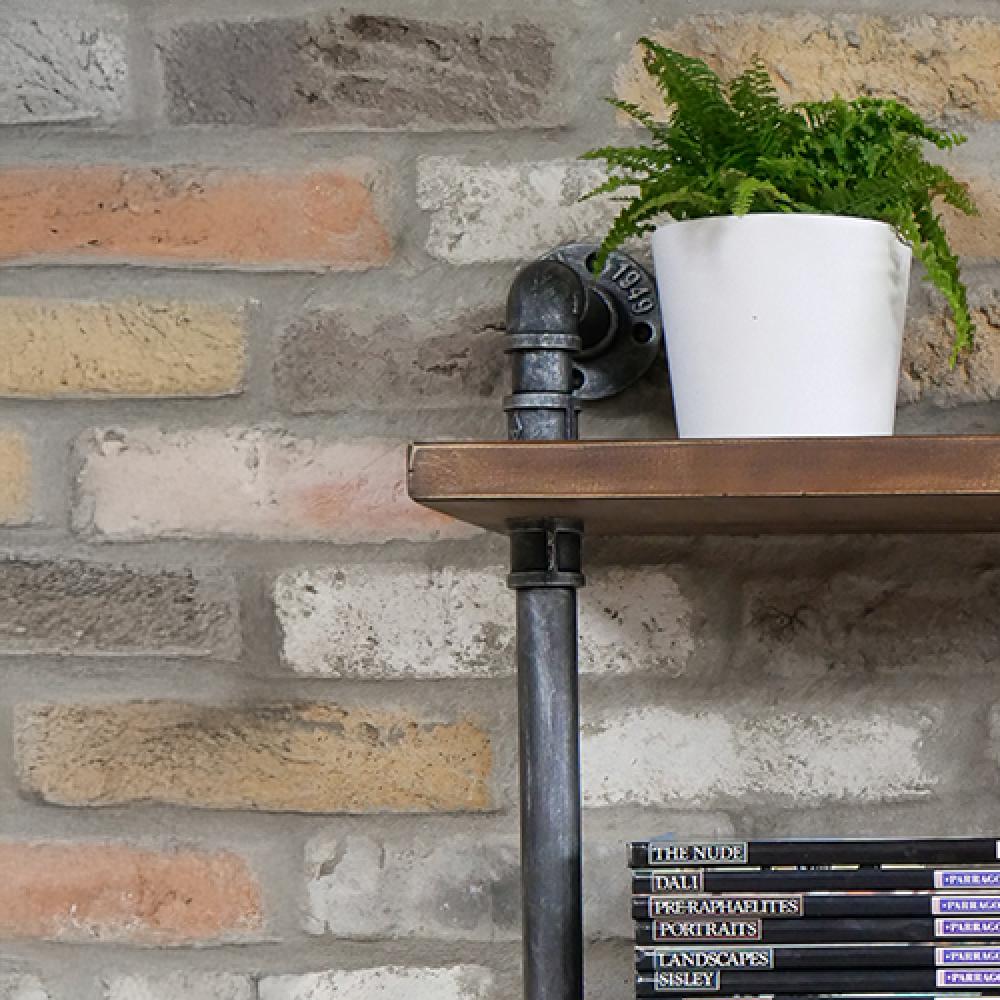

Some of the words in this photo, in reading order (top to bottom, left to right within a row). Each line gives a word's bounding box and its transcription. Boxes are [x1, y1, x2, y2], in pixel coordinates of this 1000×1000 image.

[611, 263, 654, 316] 1949
[653, 847, 688, 860] THE
[693, 847, 742, 860] NUDE
[656, 875, 698, 890] DALI
[661, 921, 758, 936] PORTRAITS
[659, 952, 769, 967] LANDSCAPES
[658, 971, 714, 987] SISLEY
